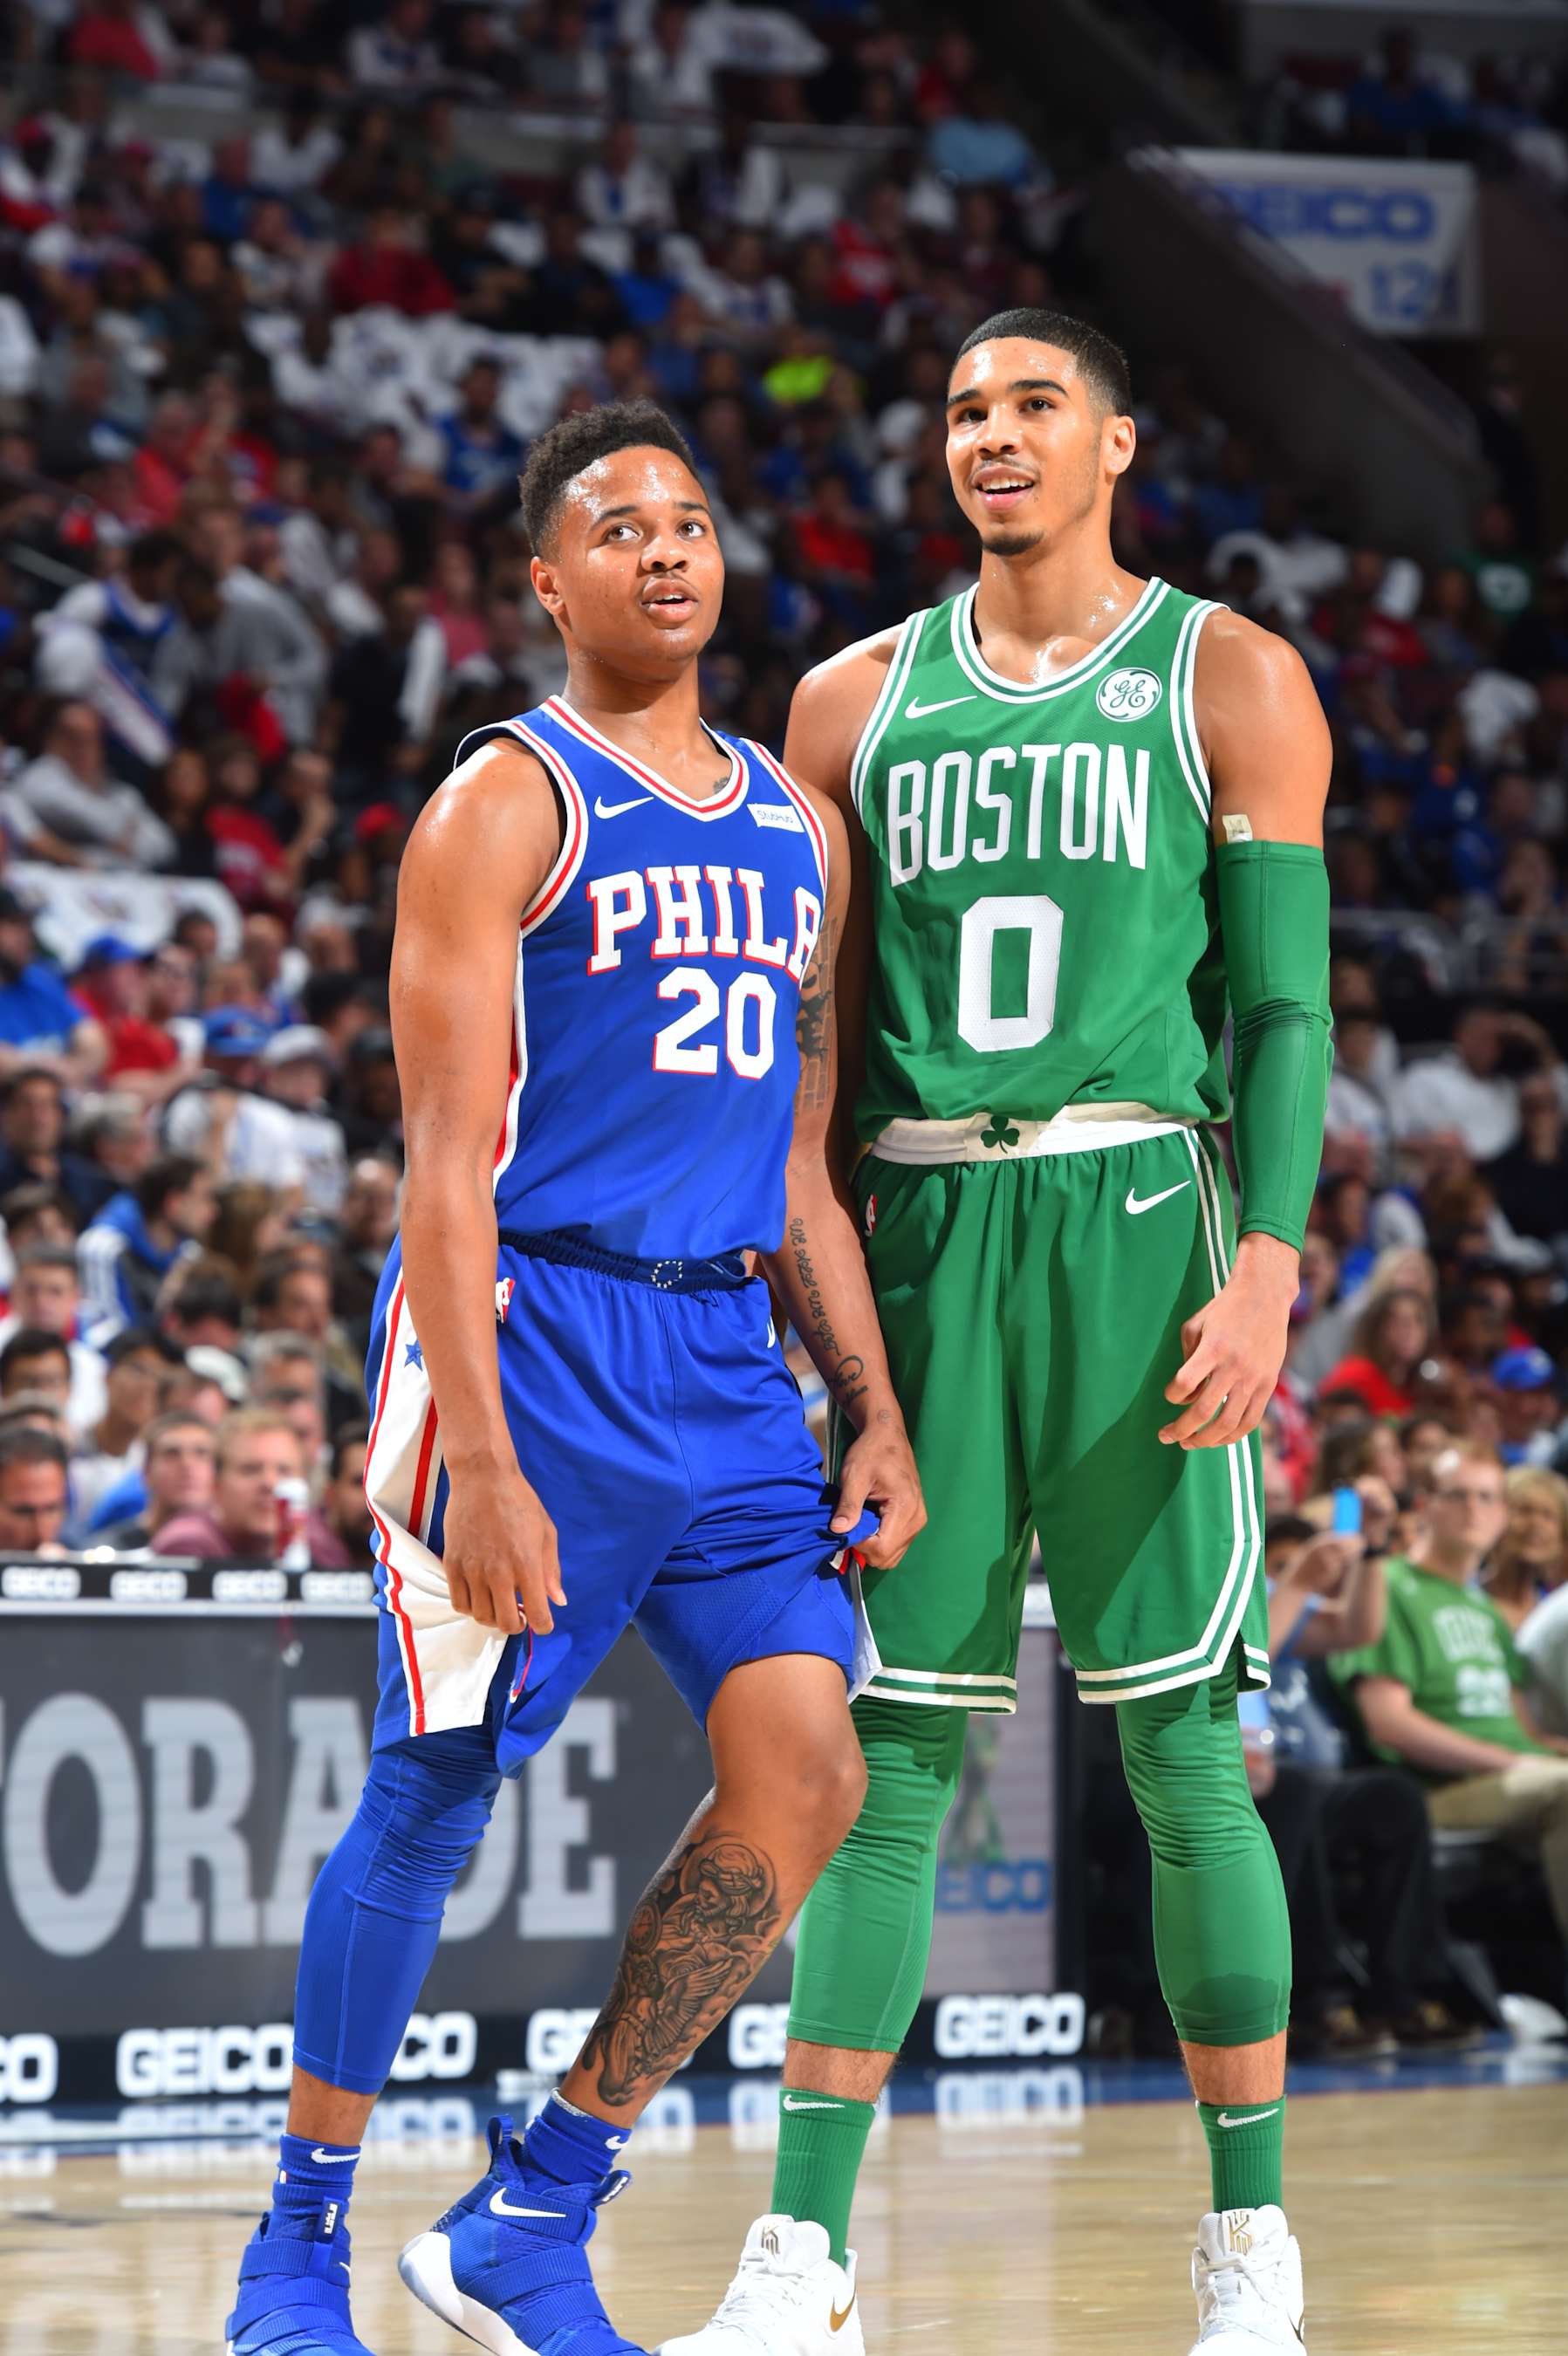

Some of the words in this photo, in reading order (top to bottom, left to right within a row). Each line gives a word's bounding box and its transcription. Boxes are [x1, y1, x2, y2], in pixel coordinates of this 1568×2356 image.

[887, 742, 1151, 887] BOSTON
[586, 865, 823, 983] PHILA
[957, 894, 1065, 1053] 0
[652, 966, 777, 1079] 20
[935, 1859, 1054, 1913] EICO
[116, 2022, 295, 2098] GEICO
[935, 1994, 1085, 2058] GEICO
